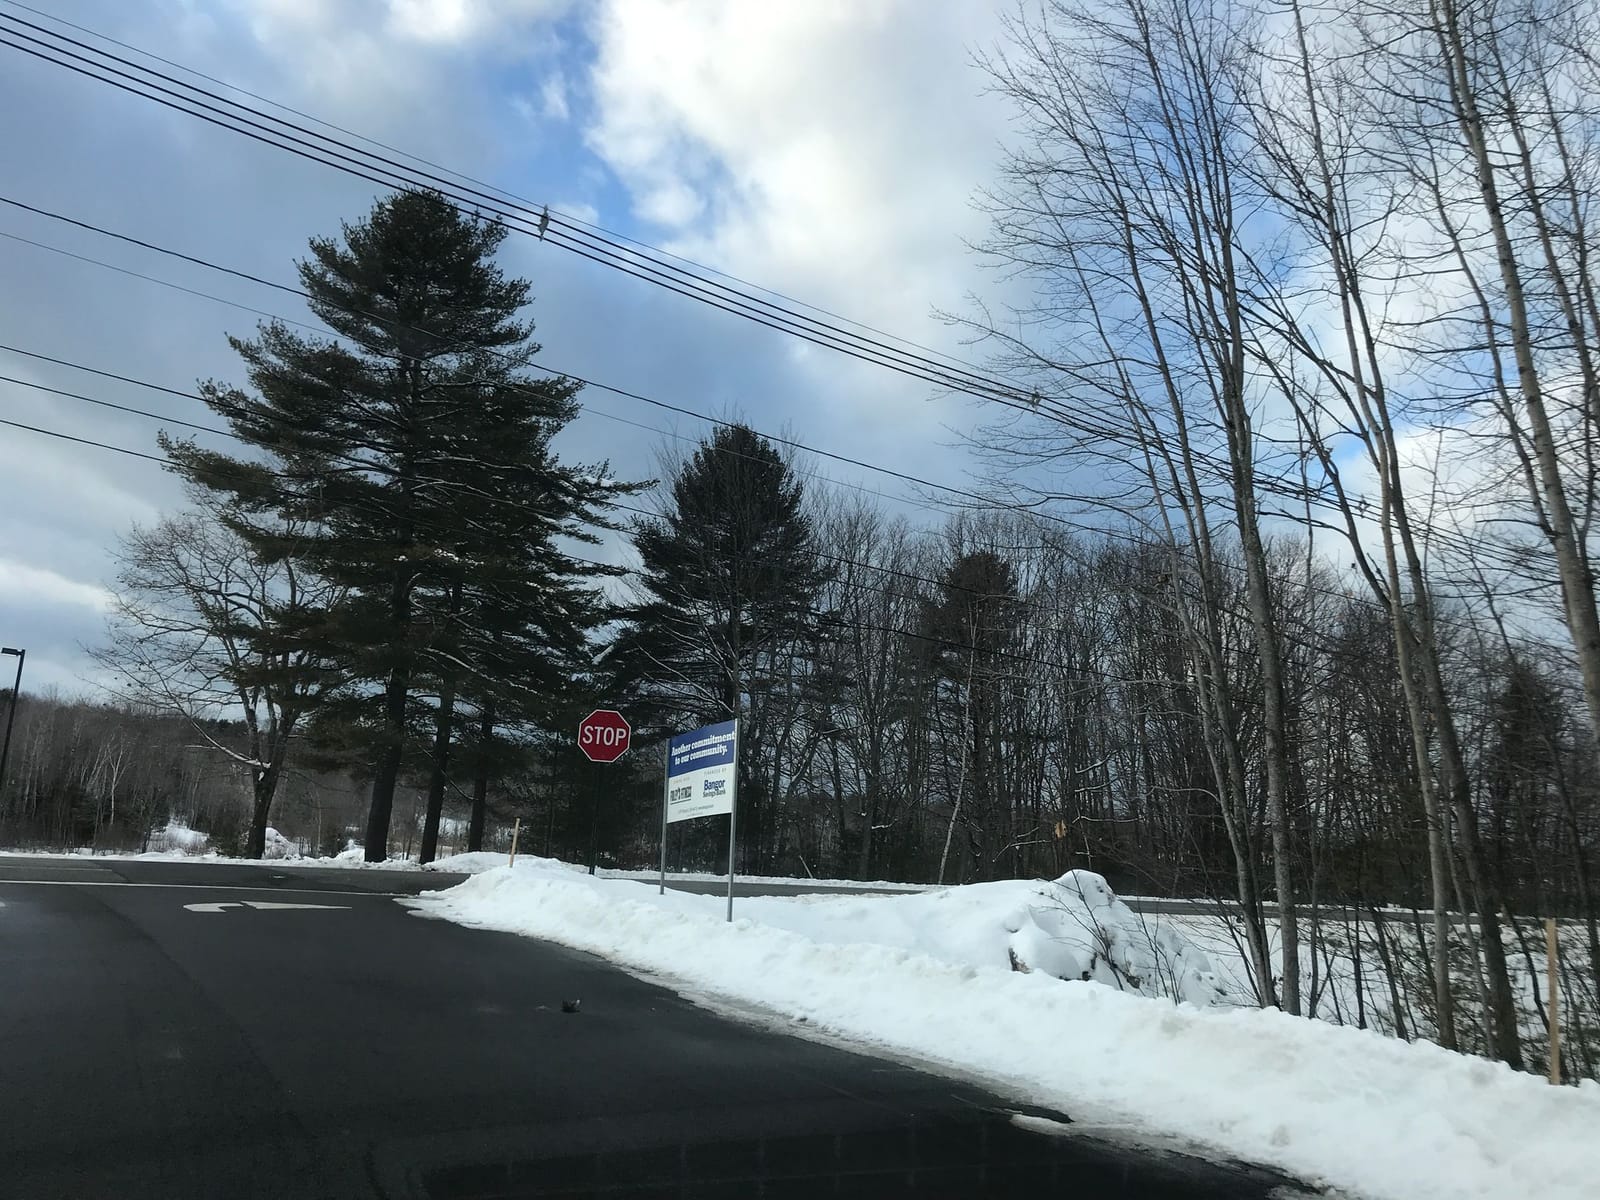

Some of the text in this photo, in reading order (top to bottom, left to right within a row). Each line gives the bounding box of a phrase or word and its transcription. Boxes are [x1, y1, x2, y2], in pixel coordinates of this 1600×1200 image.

[582, 725, 627, 746] STOP
[671, 731, 735, 756] Another commitment
[674, 756, 680, 765] to
[681, 754, 689, 763] our
[704, 779, 726, 791] Bangor
